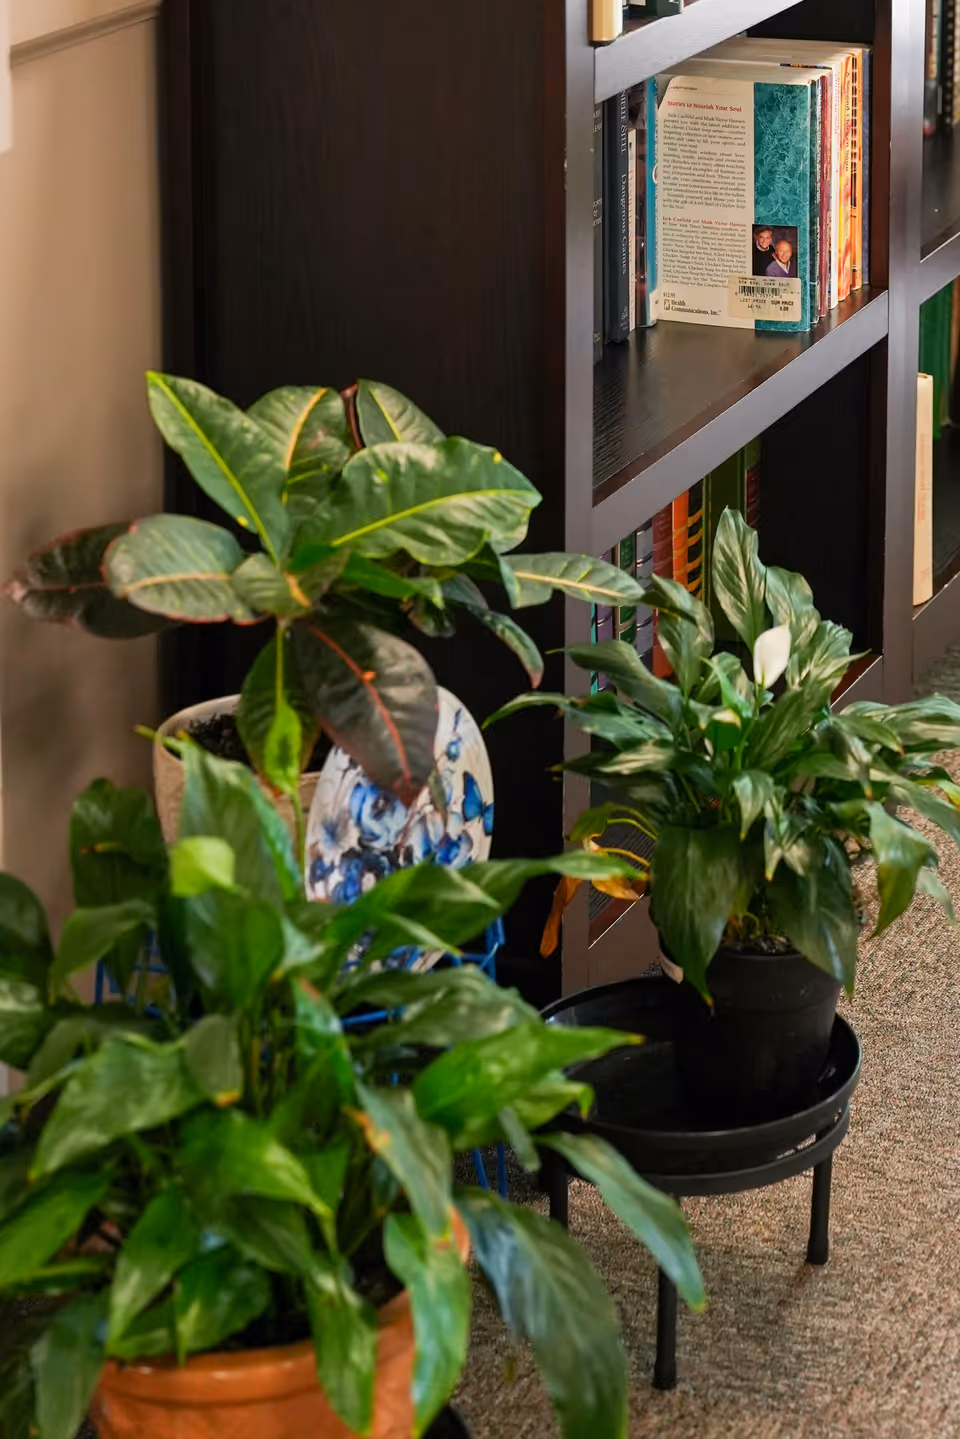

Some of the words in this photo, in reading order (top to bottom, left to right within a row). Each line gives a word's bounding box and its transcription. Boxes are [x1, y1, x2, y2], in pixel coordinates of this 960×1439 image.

[619, 90, 627, 123] NIELLE
[619, 173, 627, 234] Dangerous
[671, 306, 710, 315] Communications,
